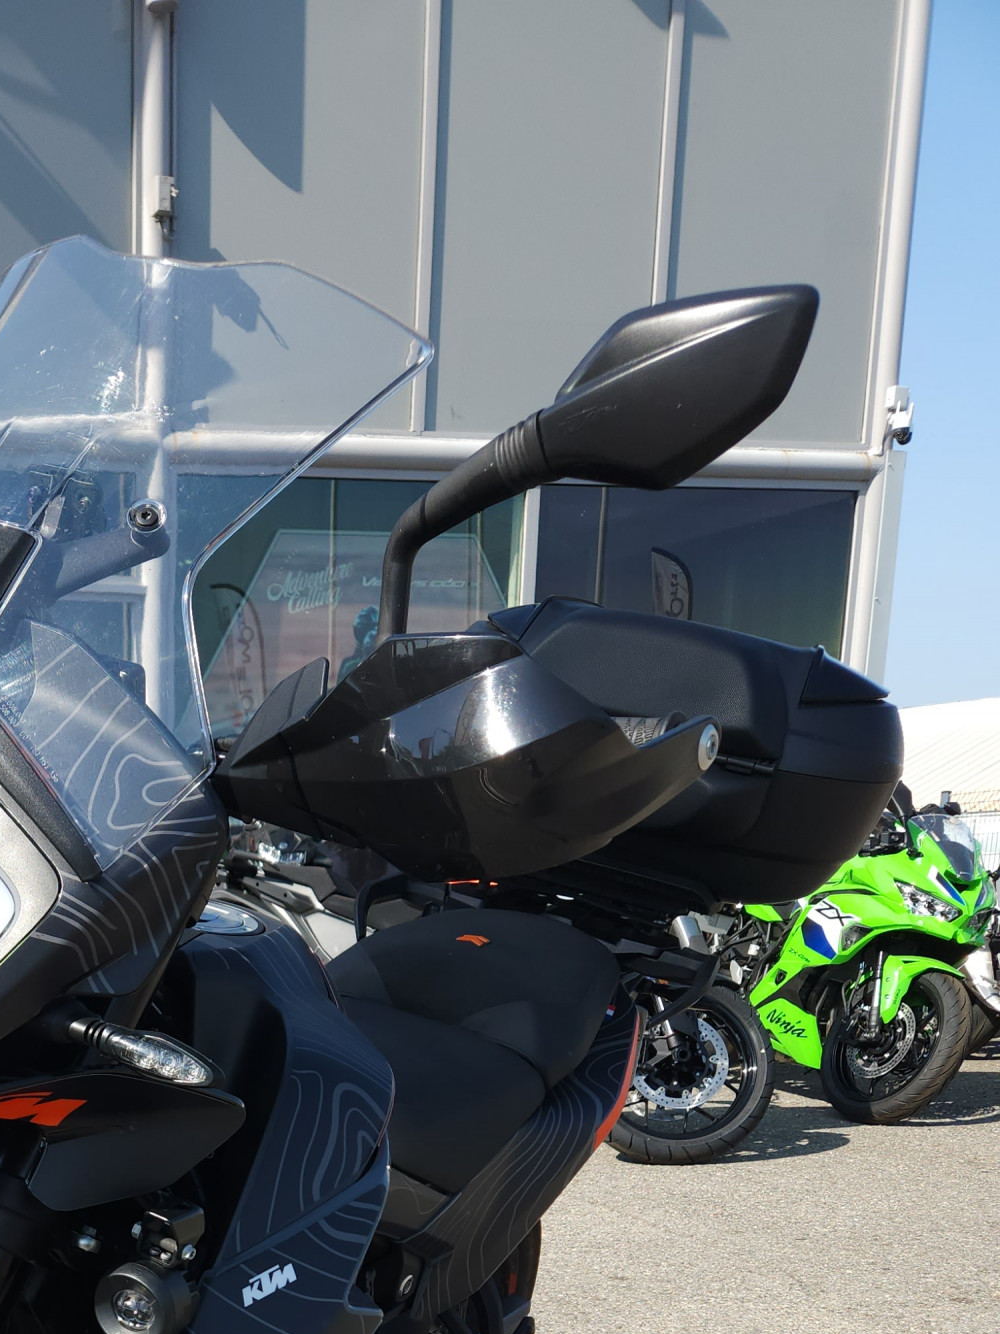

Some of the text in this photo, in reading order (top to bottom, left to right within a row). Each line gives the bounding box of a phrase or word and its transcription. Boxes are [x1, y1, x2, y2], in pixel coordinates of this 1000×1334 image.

[814, 900, 853, 926] ZX
[766, 1008, 808, 1038] Ninja
[241, 1263, 297, 1307] KTM
